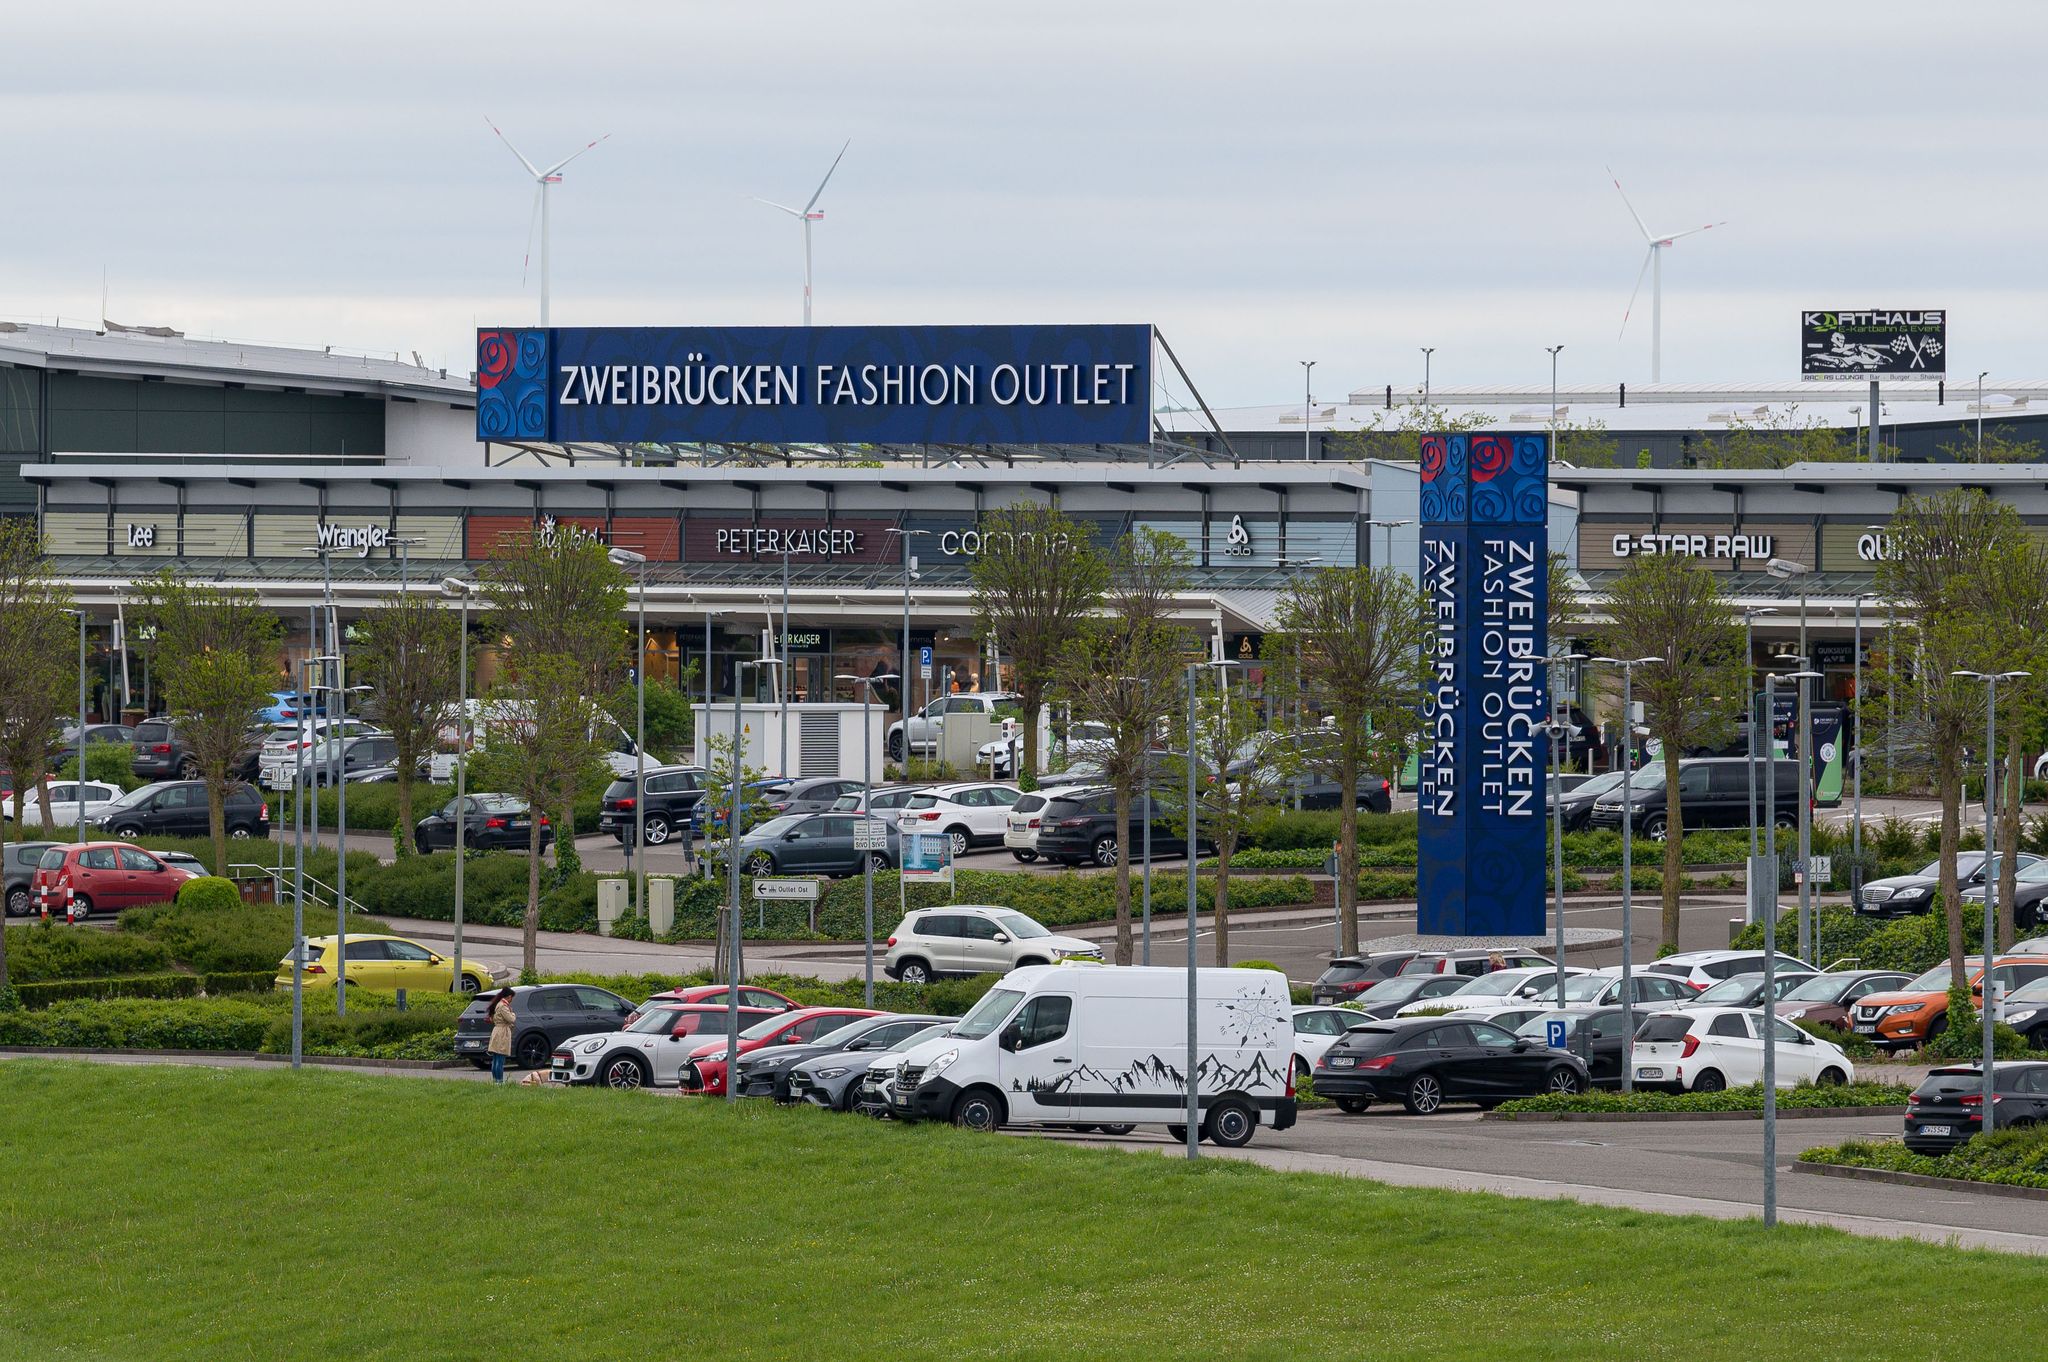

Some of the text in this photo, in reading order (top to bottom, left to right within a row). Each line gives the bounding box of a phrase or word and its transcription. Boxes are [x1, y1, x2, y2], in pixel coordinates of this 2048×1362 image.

[560, 353, 1134, 405] ZWEIBRÜCKEN FASHION OUTLET
[127, 524, 154, 547] Lee
[317, 523, 388, 558] Wrangler
[717, 529, 855, 554] PETER KAISER
[1612, 534, 1772, 559] G-STAR RAW
[1223, 545, 1251, 556] odlo
[793, 634, 821, 645] KAISER
[922, 649, 929, 664] P
[1437, 541, 1460, 816] ZWEIBRÜCKEN
[1482, 541, 1504, 815] FASHION OUTLET
[1507, 541, 1543, 816] ZWEIBRÜCKEN
[1551, 1024, 1562, 1045] P
[1235, 1050, 1242, 1059] S
